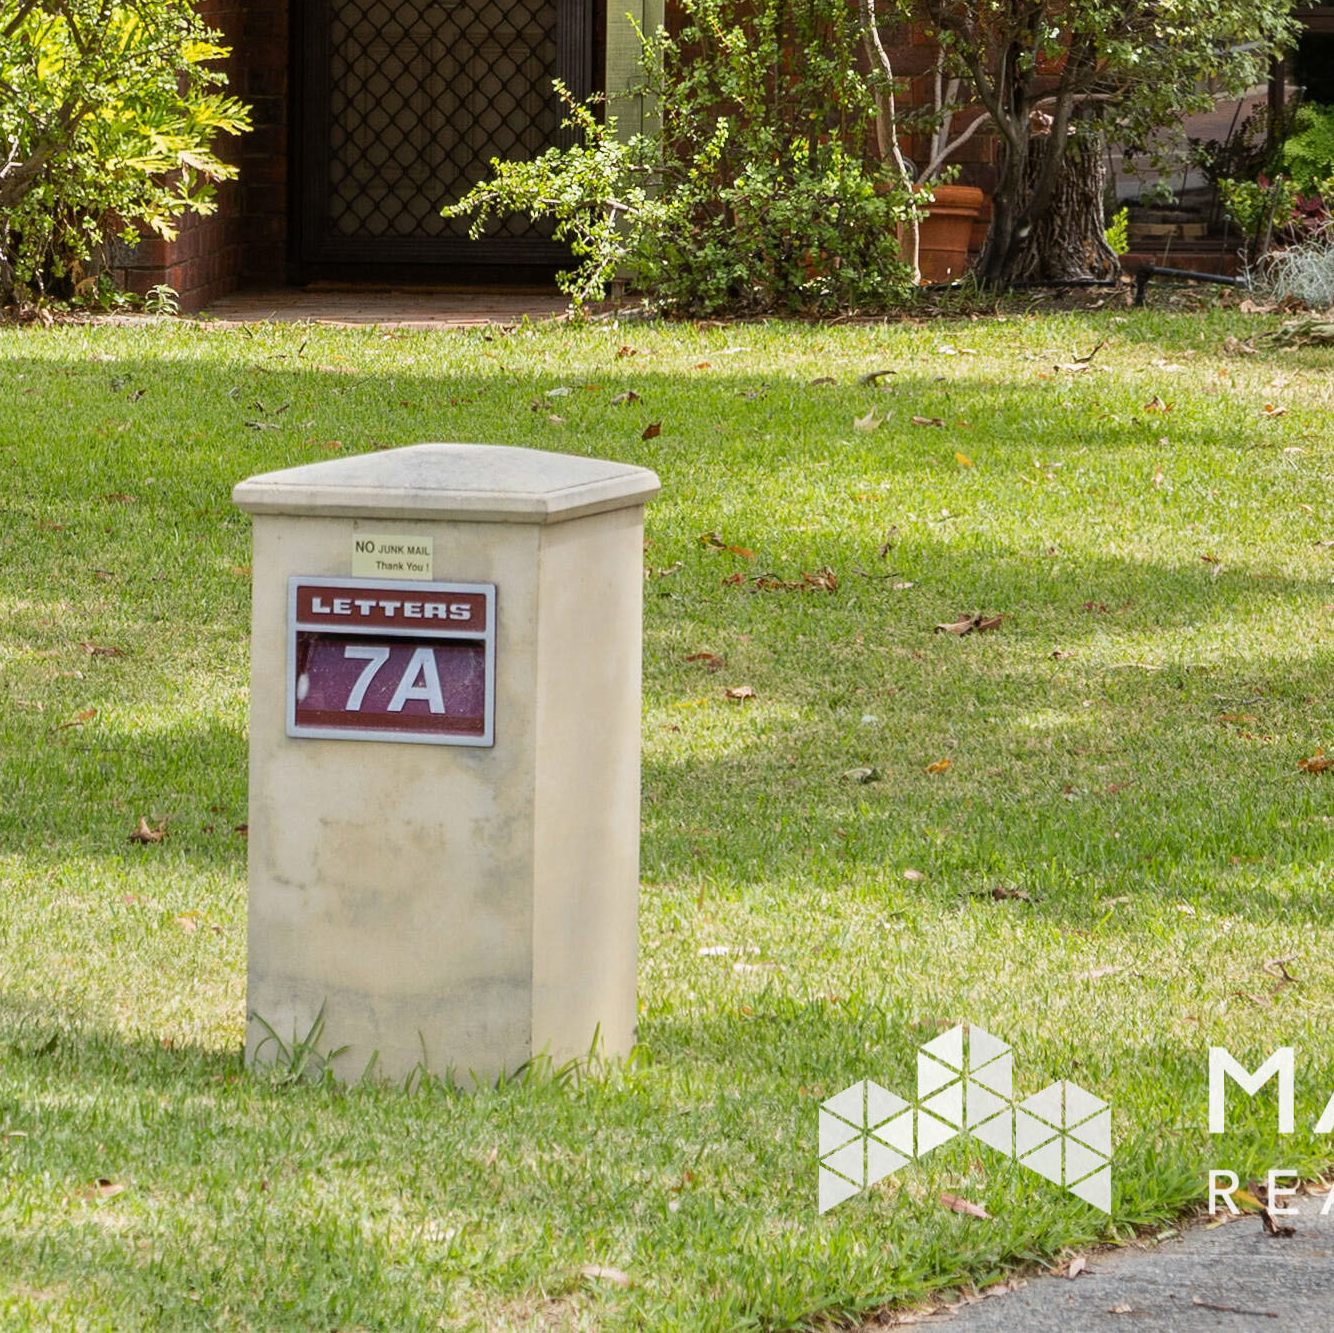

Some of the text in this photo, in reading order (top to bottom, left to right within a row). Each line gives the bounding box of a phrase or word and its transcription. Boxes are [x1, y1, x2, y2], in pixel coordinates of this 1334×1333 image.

[355, 540, 431, 556] NO JUNK MAIL
[375, 560, 404, 572] Thank
[406, 562, 423, 573] You
[311, 596, 472, 621] LETTERS
[343, 645, 446, 715] 7A
